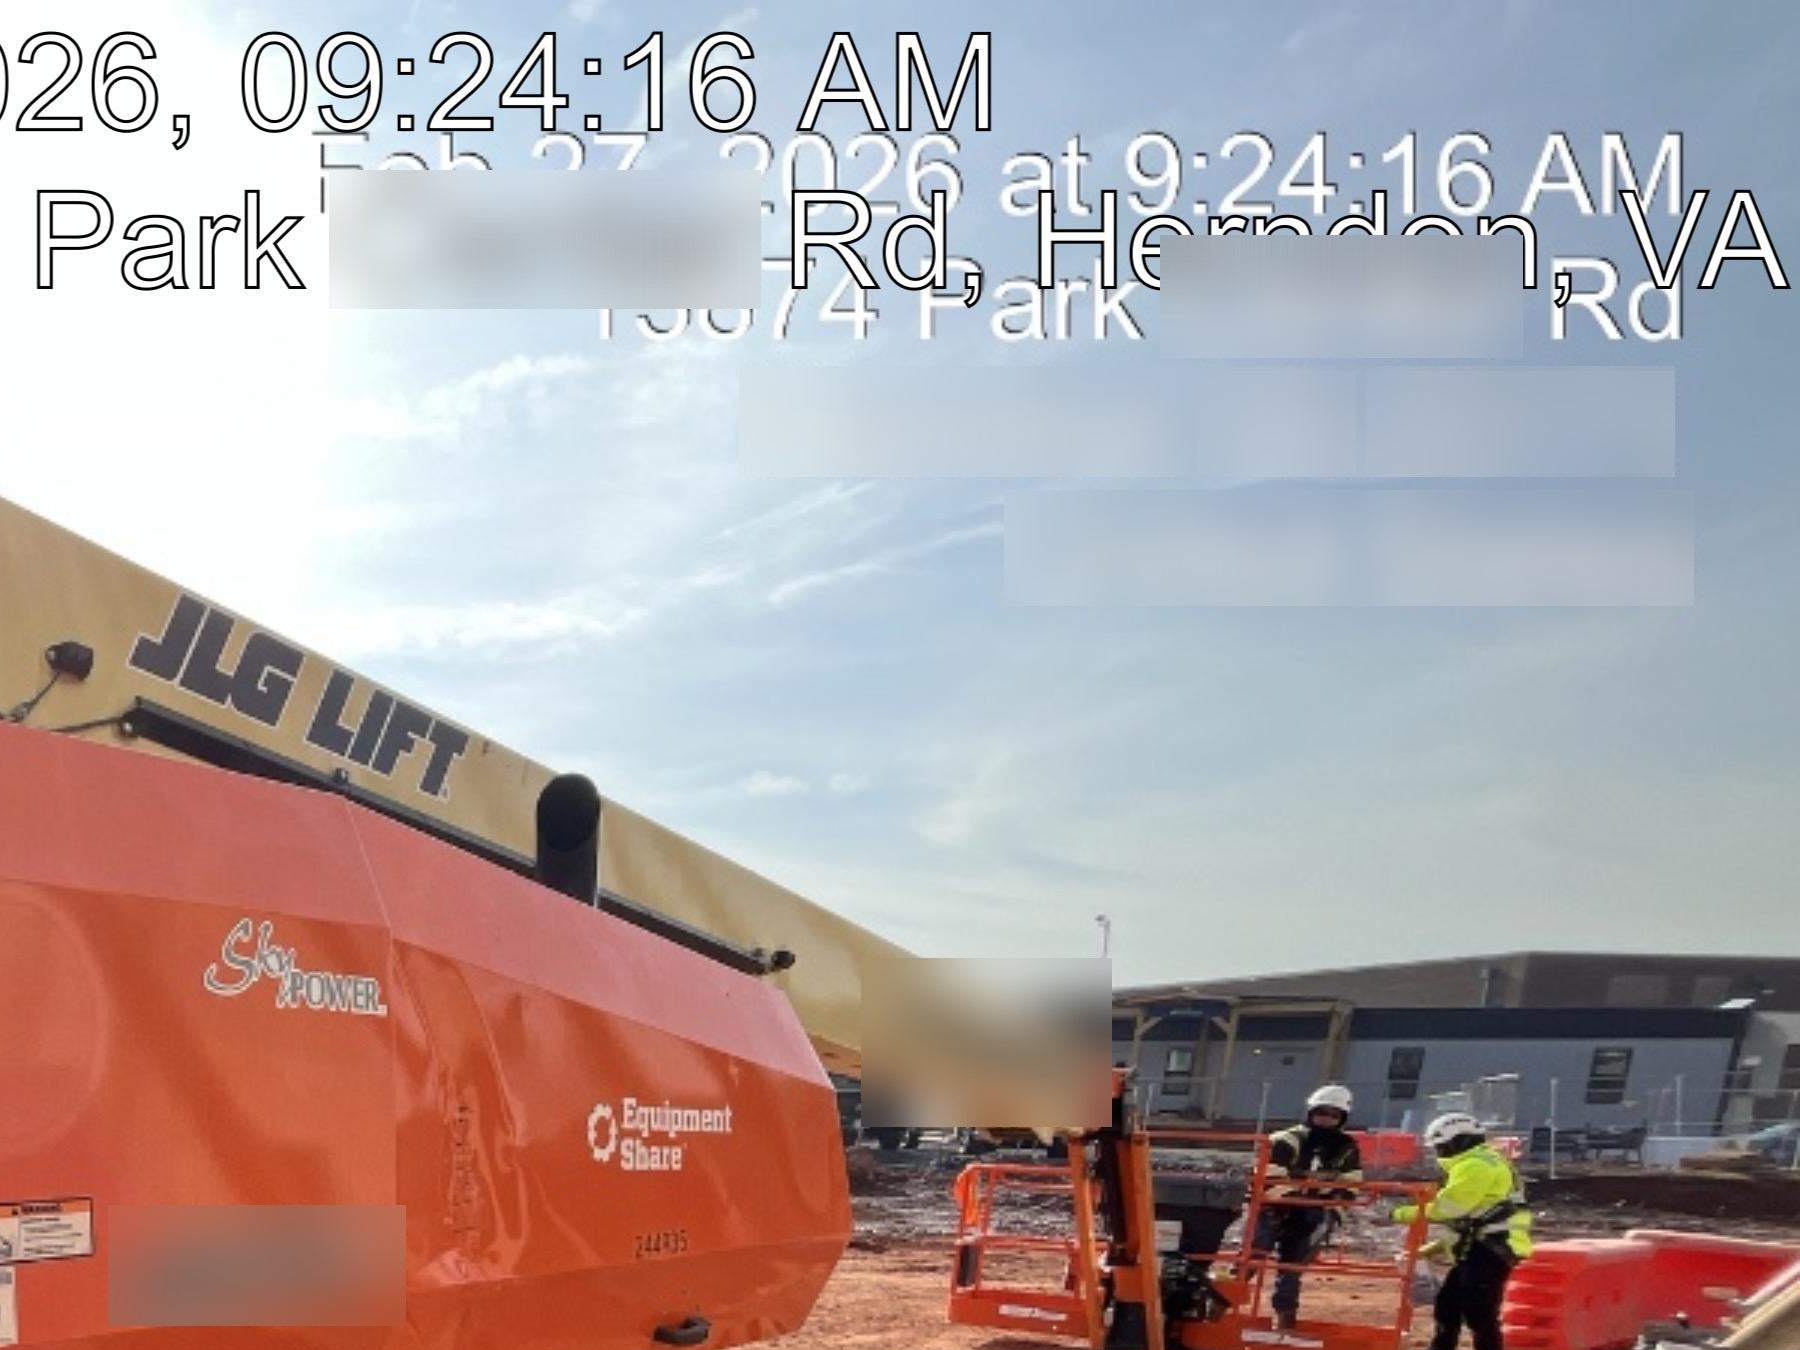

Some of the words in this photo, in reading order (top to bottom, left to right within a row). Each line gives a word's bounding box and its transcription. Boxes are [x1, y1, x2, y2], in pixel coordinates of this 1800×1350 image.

[128, 593, 304, 728] JLG
[305, 667, 471, 796] LIFT
[621, 1097, 732, 1138] Equipment
[620, 1139, 683, 1171] Share
